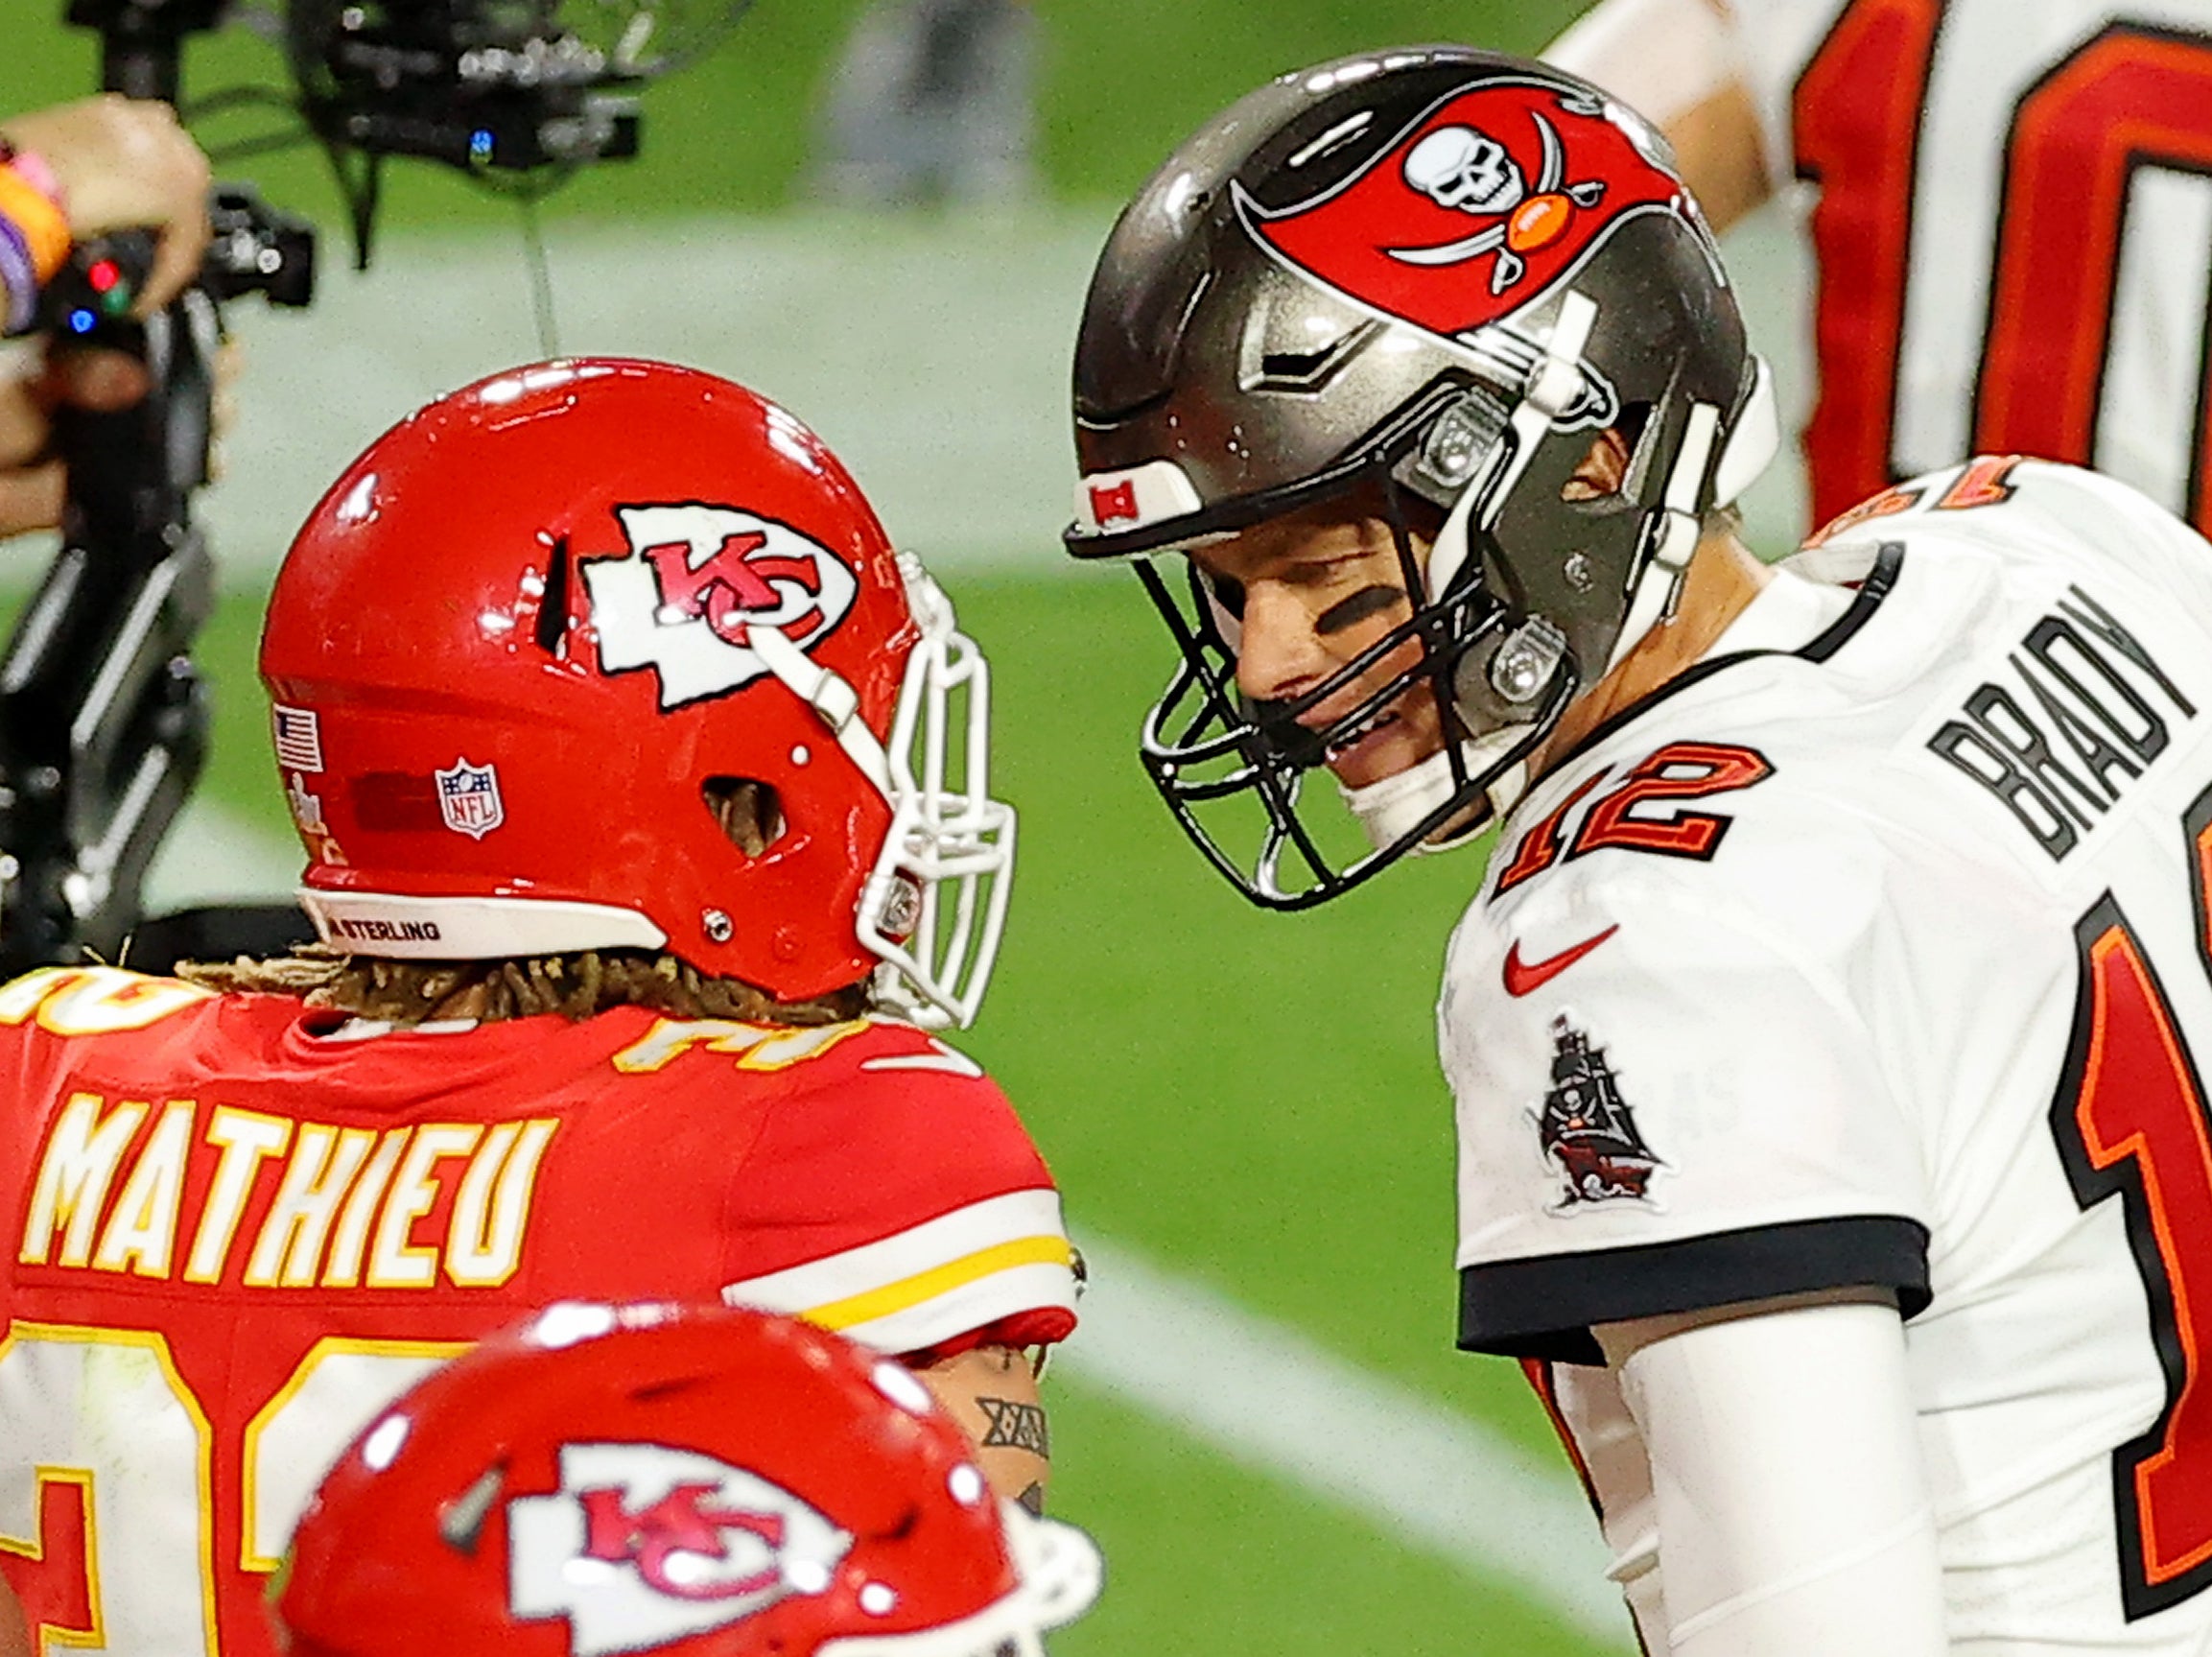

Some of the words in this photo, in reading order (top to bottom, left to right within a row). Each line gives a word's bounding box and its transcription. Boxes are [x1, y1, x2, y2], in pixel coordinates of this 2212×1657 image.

[1925, 582, 2198, 863] BRADY
[449, 794, 495, 824] NFL
[1488, 741, 1778, 904] 12
[18, 1091, 561, 1289] MATHIEU
[576, 1480, 787, 1602] KC
